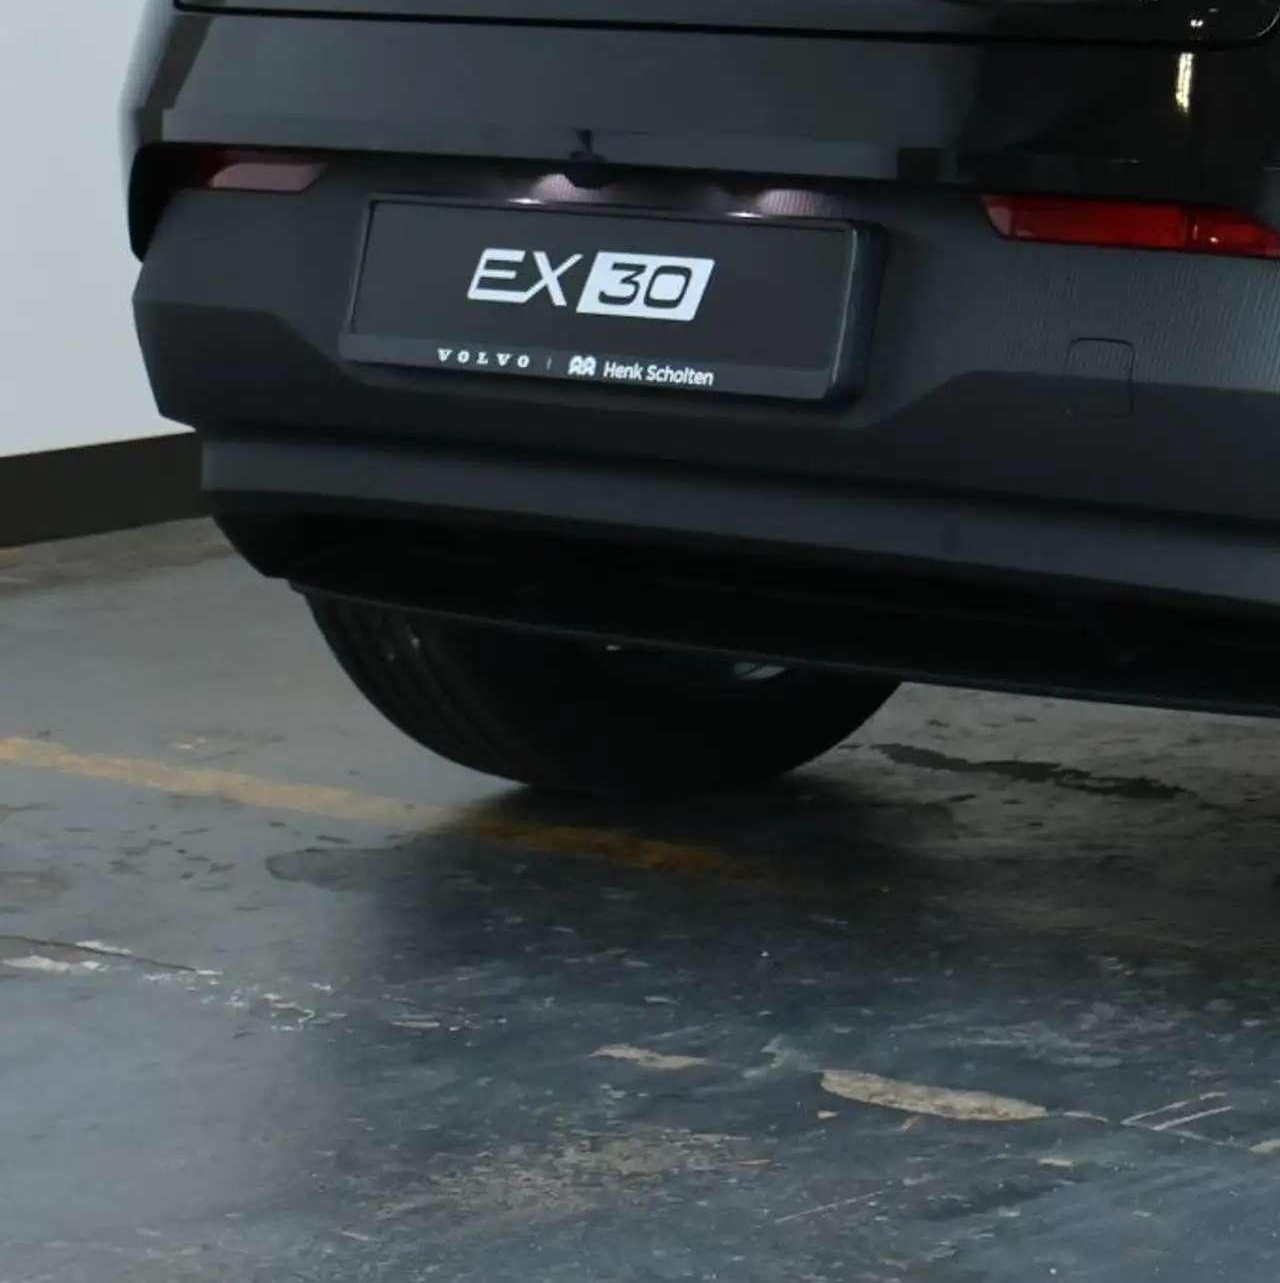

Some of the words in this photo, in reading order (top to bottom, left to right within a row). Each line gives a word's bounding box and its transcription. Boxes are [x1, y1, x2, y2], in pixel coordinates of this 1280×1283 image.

[467, 247, 714, 321] EX30
[438, 348, 530, 368] VOLVO
[603, 361, 643, 381] Henk
[646, 364, 715, 387] Scholten
